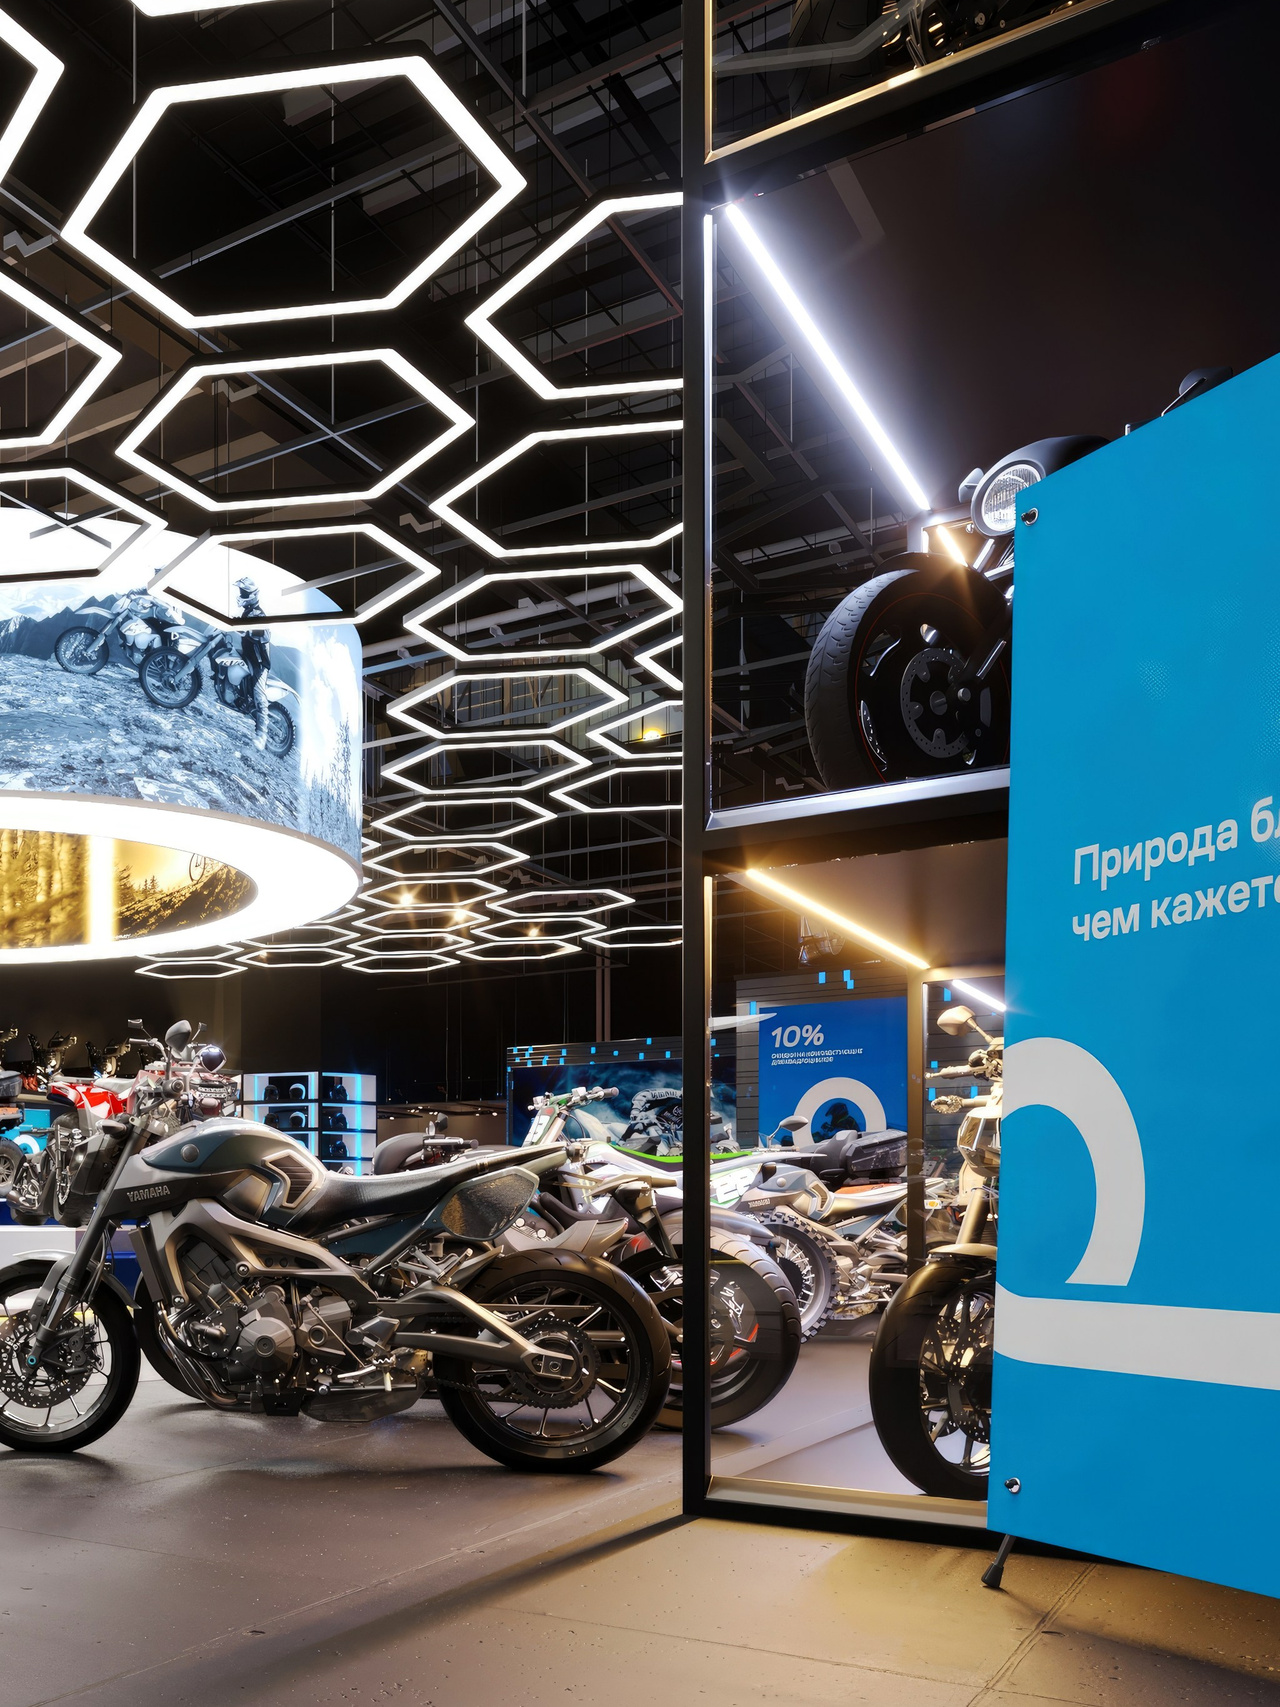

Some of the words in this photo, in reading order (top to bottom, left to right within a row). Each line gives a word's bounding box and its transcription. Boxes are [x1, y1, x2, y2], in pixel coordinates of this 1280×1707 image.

[1073, 818, 1238, 892] Природа
[1072, 903, 1140, 942] чем
[771, 1024, 825, 1048] 10%
[126, 1184, 171, 1202] YAMAHA
